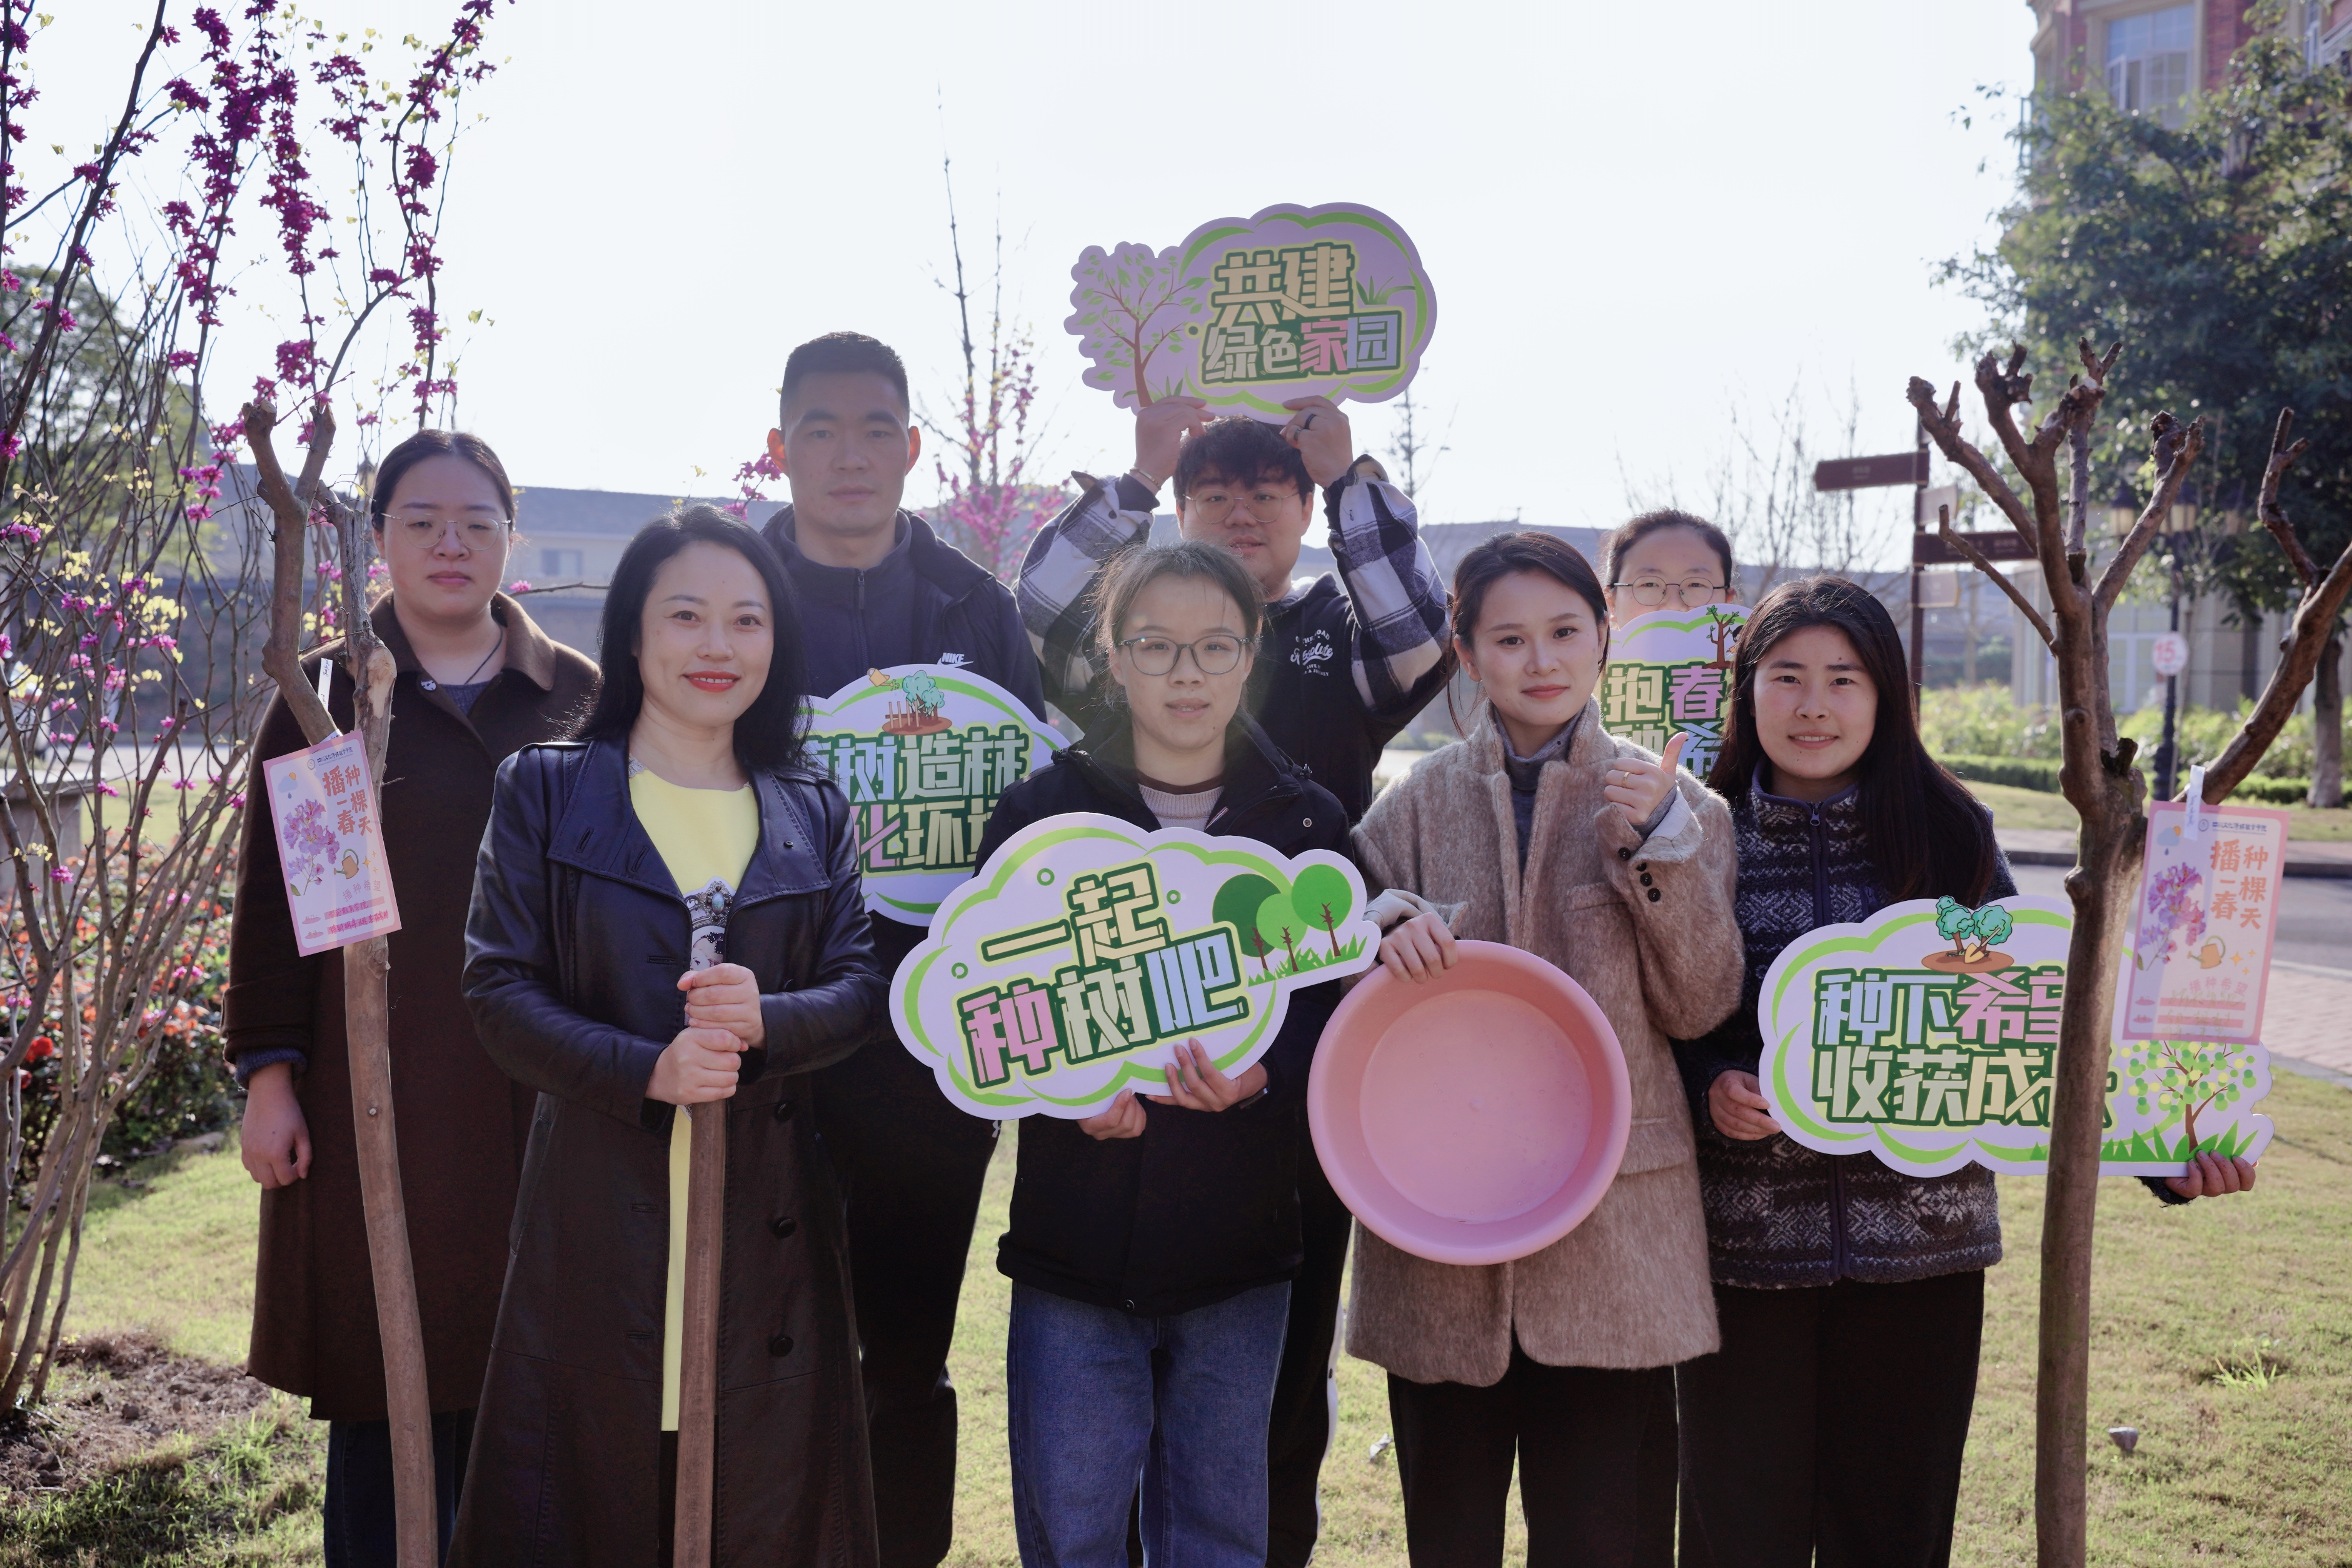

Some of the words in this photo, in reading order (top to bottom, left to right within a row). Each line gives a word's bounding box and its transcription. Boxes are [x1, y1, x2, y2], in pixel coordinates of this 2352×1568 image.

[1214, 244, 1353, 326] 共建
[1204, 314, 1400, 381] 绿色家园
[941, 652, 965, 664] NIKE
[1605, 663, 1725, 723] 抱春
[341, 878, 382, 903] 播种希望
[982, 864, 1168, 966] 一起
[960, 935, 1244, 1084] 种树吧
[2189, 977, 2249, 996] 播种希望
